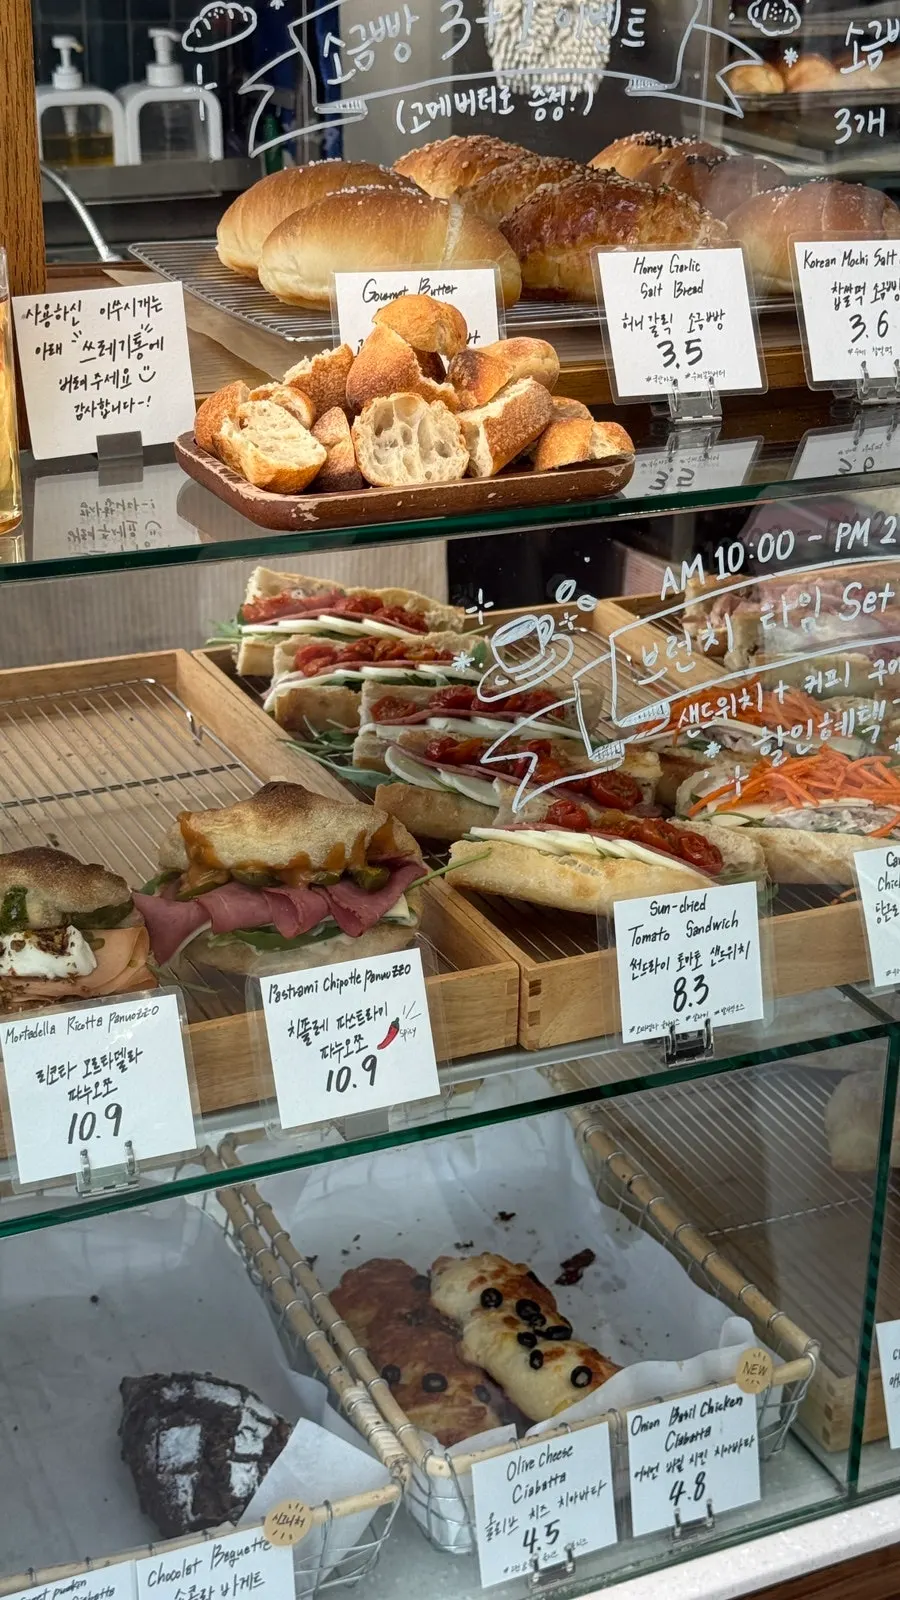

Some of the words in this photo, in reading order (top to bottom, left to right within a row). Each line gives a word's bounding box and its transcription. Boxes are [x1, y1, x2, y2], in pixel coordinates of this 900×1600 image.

[323, 3, 420, 86] 소금빵
[833, 107, 886, 145] 3개
[633, 255, 664, 280] Honey
[669, 253, 702, 275] Garlic
[803, 249, 837, 270] Korean
[841, 248, 869, 268] Mochi
[873, 247, 899, 268] Salt
[417, 277, 458, 296] Butter
[640, 282, 664, 300] Salt
[673, 278, 705, 299] Bread
[26, 300, 82, 329] 사용하신
[99, 295, 164, 322] 이쑤시개는
[686, 308, 727, 335] 소금빵
[849, 309, 890, 343] 3.6
[35, 342, 63, 361] 아래
[656, 337, 704, 370] 3.5
[660, 553, 705, 601] AM
[714, 529, 796, 581] 10:00
[834, 517, 871, 552] PM
[637, 613, 734, 686] 브런치
[760, 585, 821, 634] 타임
[838, 581, 895, 622] Set
[677, 681, 763, 739] 샌드위치
[804, 661, 850, 694] 커피
[649, 892, 708, 917] Sun-dried
[628, 923, 671, 947] Tomato
[686, 909, 739, 939] Sandwich
[629, 956, 670, 981] 썬드라이
[676, 950, 703, 973] 토마토
[710, 940, 751, 968] 샌드위치
[268, 980, 318, 1005] Pastrami
[323, 968, 363, 995] Chipotle
[673, 973, 710, 1013] 8.3
[5, 1021, 57, 1046] Mortadella
[67, 1014, 104, 1036] Ricotta
[336, 1001, 389, 1033] 파스트라미
[35, 1060, 78, 1086] 리코타
[82, 1047, 144, 1080] 모르타델라
[320, 1032, 369, 1065] 파누오쪼
[67, 1076, 119, 1106] 파누오쪼
[326, 1054, 379, 1094] 10.9
[67, 1102, 124, 1146] 10.9
[742, 1360, 769, 1377] NEW
[630, 1414, 661, 1437] Onion
[699, 1394, 744, 1419] Chicken
[506, 1455, 536, 1483] Olive
[538, 1443, 575, 1469] Cheese
[713, 1432, 756, 1460] 치아바타
[512, 1470, 568, 1506] Ciabatta
[668, 1470, 707, 1508] 4.8
[484, 1511, 521, 1543] 올리브
[528, 1503, 552, 1521] 치즈
[556, 1478, 608, 1510] 치아바타
[522, 1518, 562, 1554] 4.5
[220, 1570, 266, 1597] 바게트
